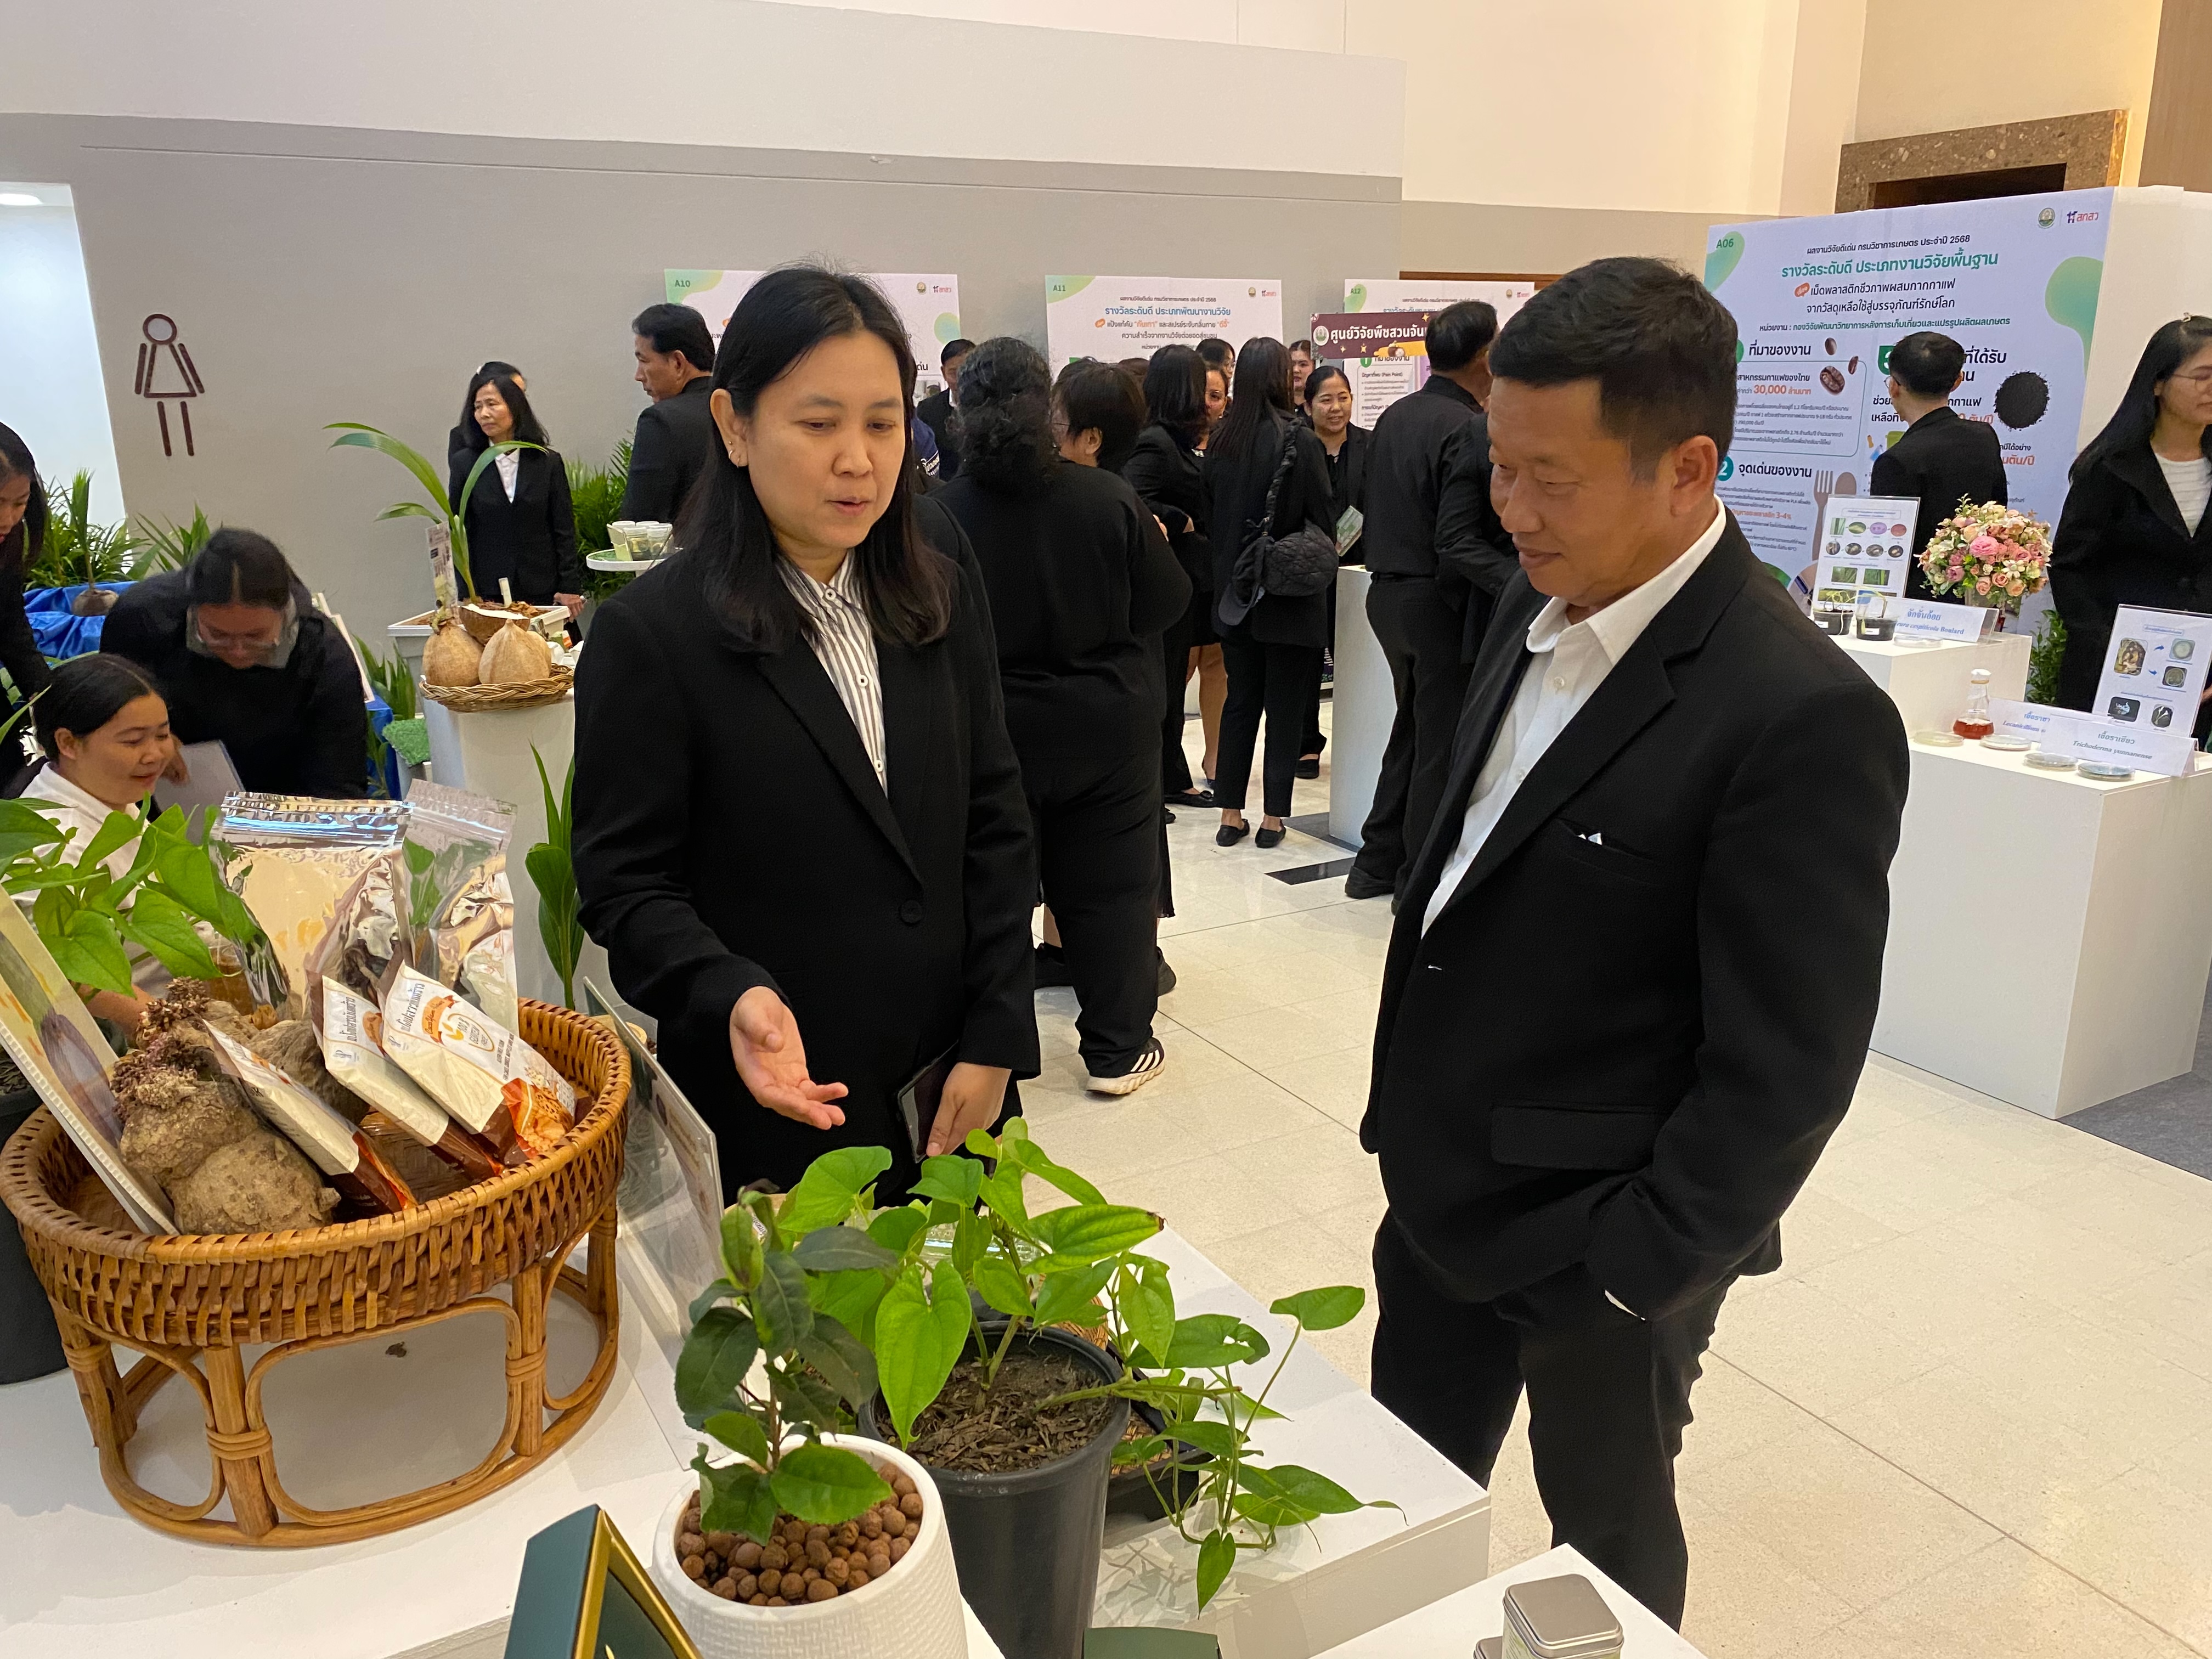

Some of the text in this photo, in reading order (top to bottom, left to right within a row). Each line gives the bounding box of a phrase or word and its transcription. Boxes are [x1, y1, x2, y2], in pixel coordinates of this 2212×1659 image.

[1716, 238, 1734, 249] A06
[1807, 235, 1970, 254] ผลงานวิจัยดีเด่น กรมวิชาการเกษตร ประจำปี 2568
[1782, 247, 1999, 277] รางวัลระดับดี ประเภทงานวิจัยพื้นฐาน
[1811, 278, 1956, 296] เม็ดพลาสติกชีวภาพผสมกากกาแฟ
[1105, 306, 1231, 316] รางวัลระดับดี ประเภทพัฒนางานวิจัย
[1807, 295, 1955, 315] จากวัสดุเหลือใช้สู่บรรจุภัณฑ์รักษ์โลก
[1330, 324, 1426, 345] ศูนย์วิจัยพืชสวนจัน
[1759, 323, 1787, 332] หน่วยงาน
[1749, 340, 1811, 356] ที่มาของงาน
[1753, 385, 1787, 395] 30,000
[1739, 461, 1812, 477] จุดเด่นของงาน
[1908, 606, 1942, 621] จักจั่นอ้อย
[2098, 730, 2135, 744] เชื้อราเขียว
[2073, 740, 2112, 753] Trichoderma
